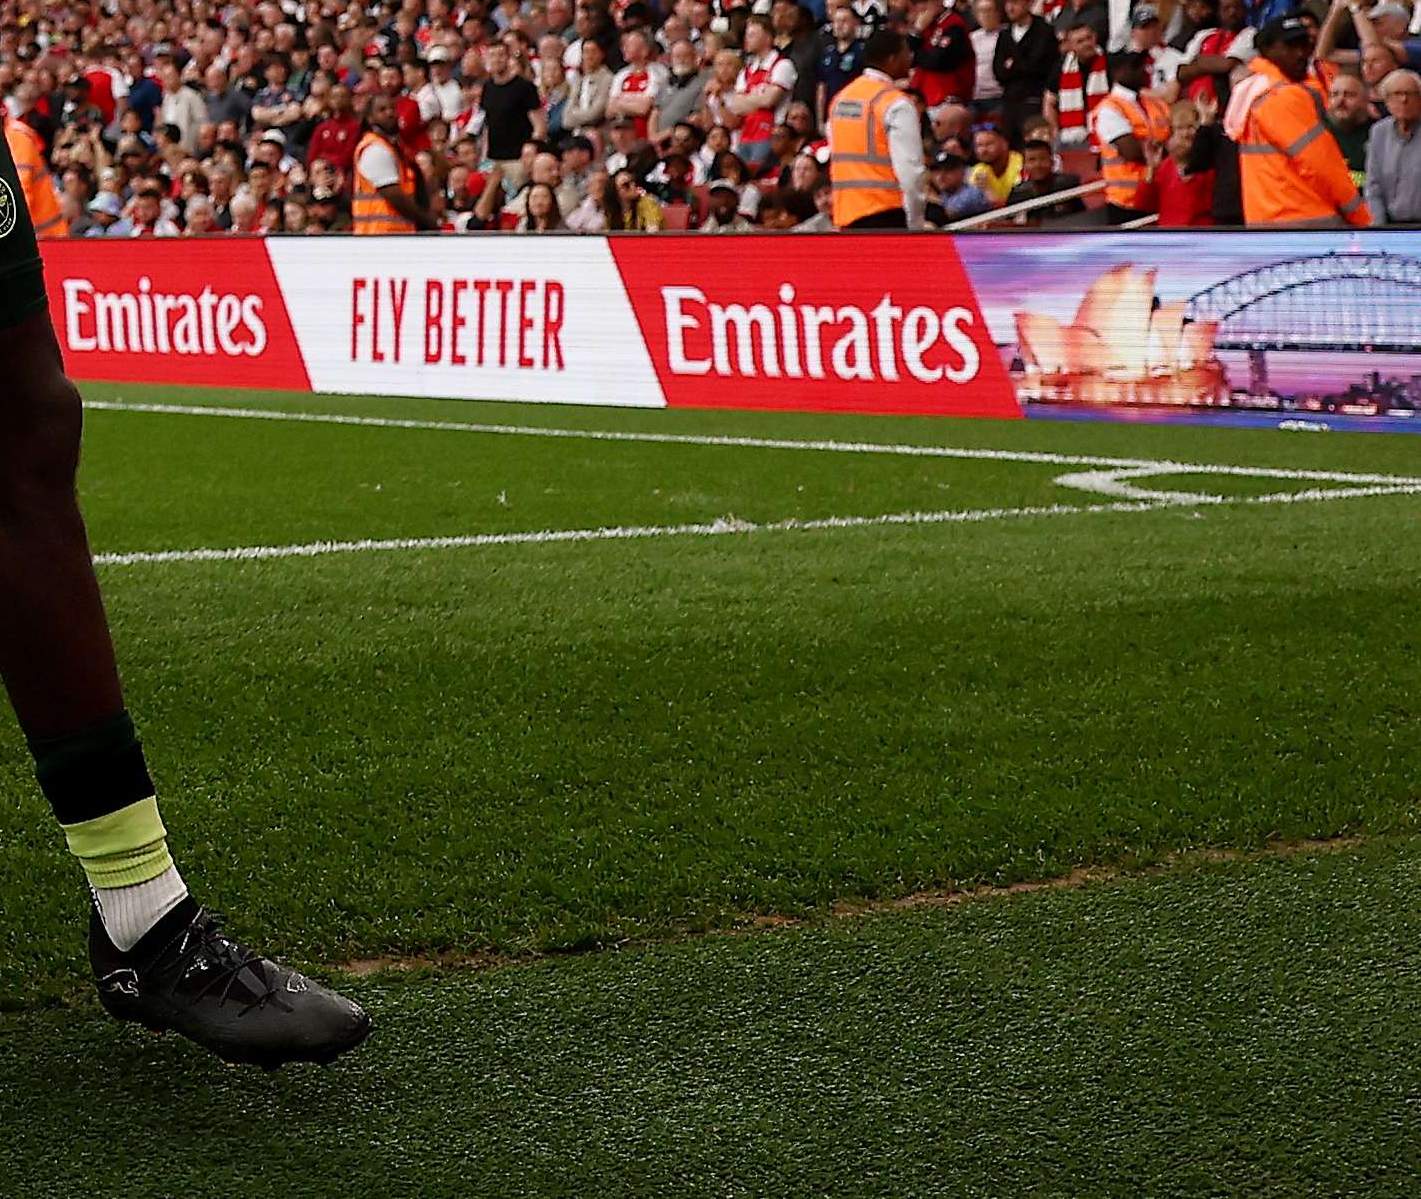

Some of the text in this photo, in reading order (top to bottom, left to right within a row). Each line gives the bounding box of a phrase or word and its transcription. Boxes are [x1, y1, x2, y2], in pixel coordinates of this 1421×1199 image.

[62, 275, 982, 384] Emirates FLY BETTER Emirates
